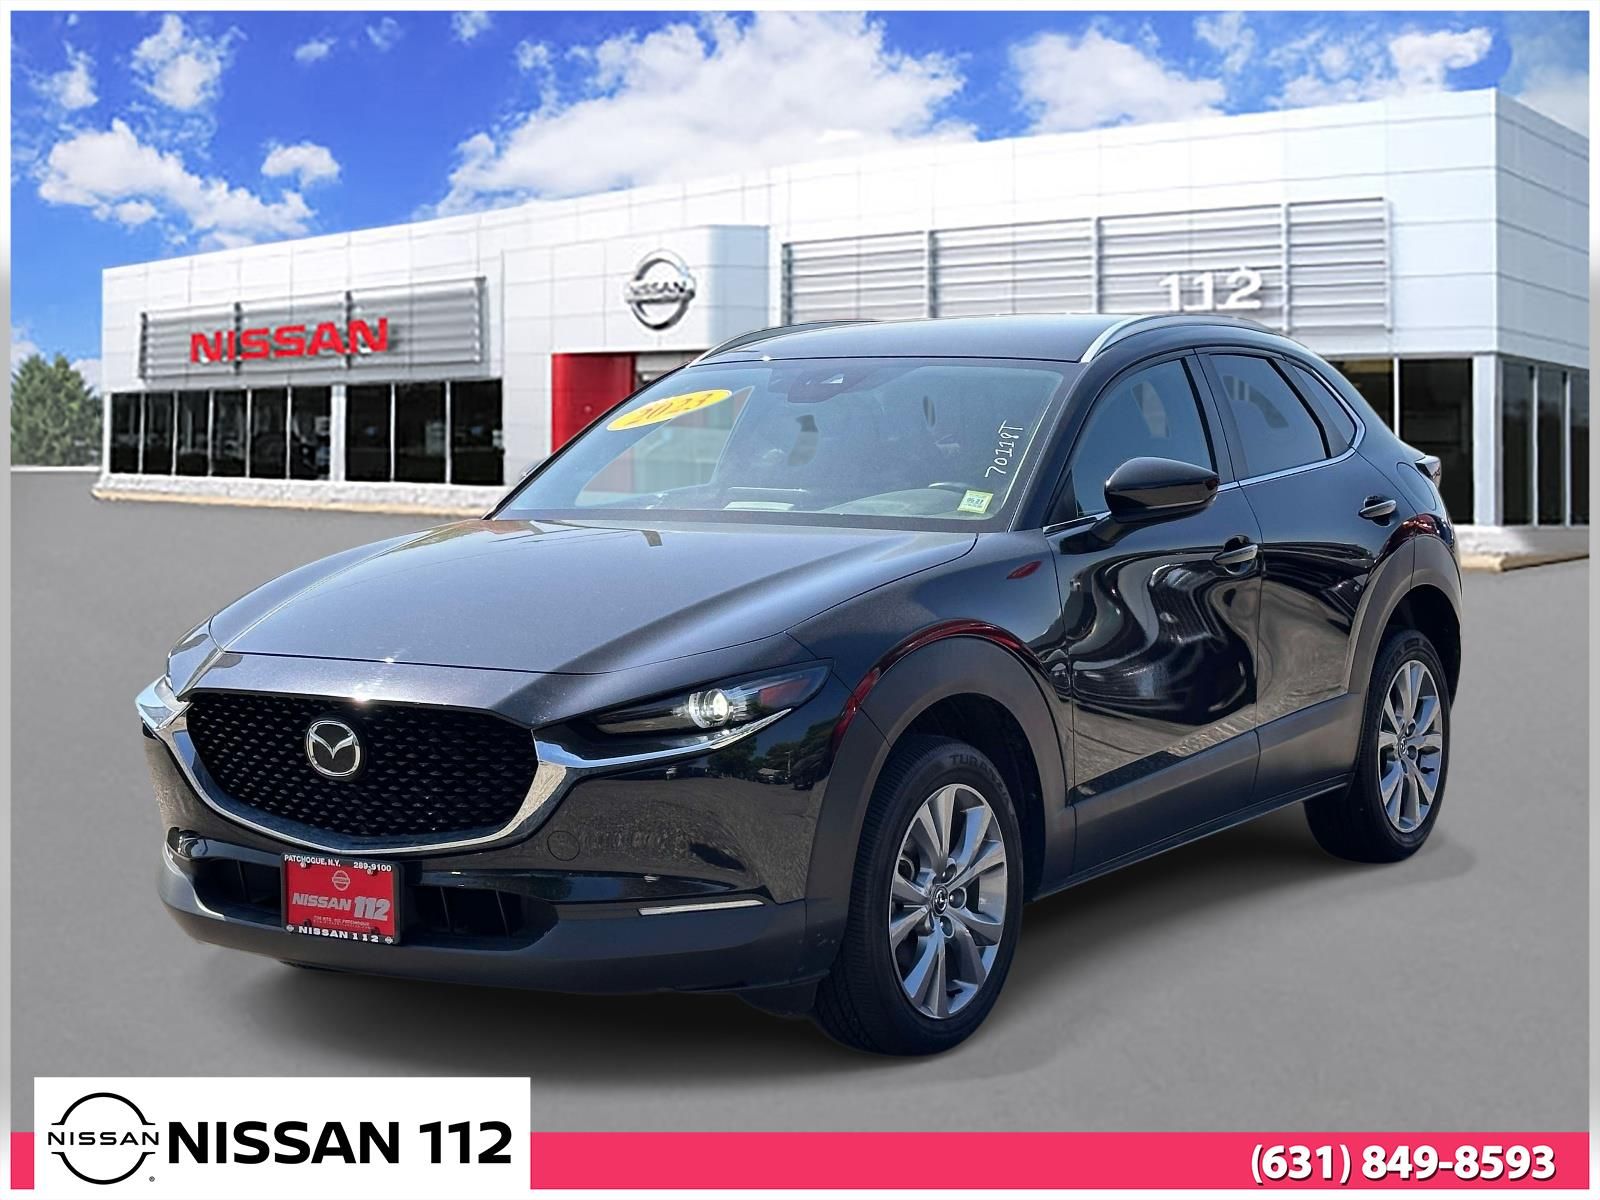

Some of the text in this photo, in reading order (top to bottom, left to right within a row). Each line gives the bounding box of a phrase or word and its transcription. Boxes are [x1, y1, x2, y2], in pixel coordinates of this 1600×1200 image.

[625, 279, 689, 298] NISSAN
[1158, 266, 1262, 312] 112
[190, 316, 389, 364] NISSAN
[984, 419, 1024, 478] 70118T
[353, 861, 392, 872] 289-9100
[292, 892, 352, 911] NISSAN
[353, 895, 391, 921] 112
[298, 925, 349, 939] NISSAN
